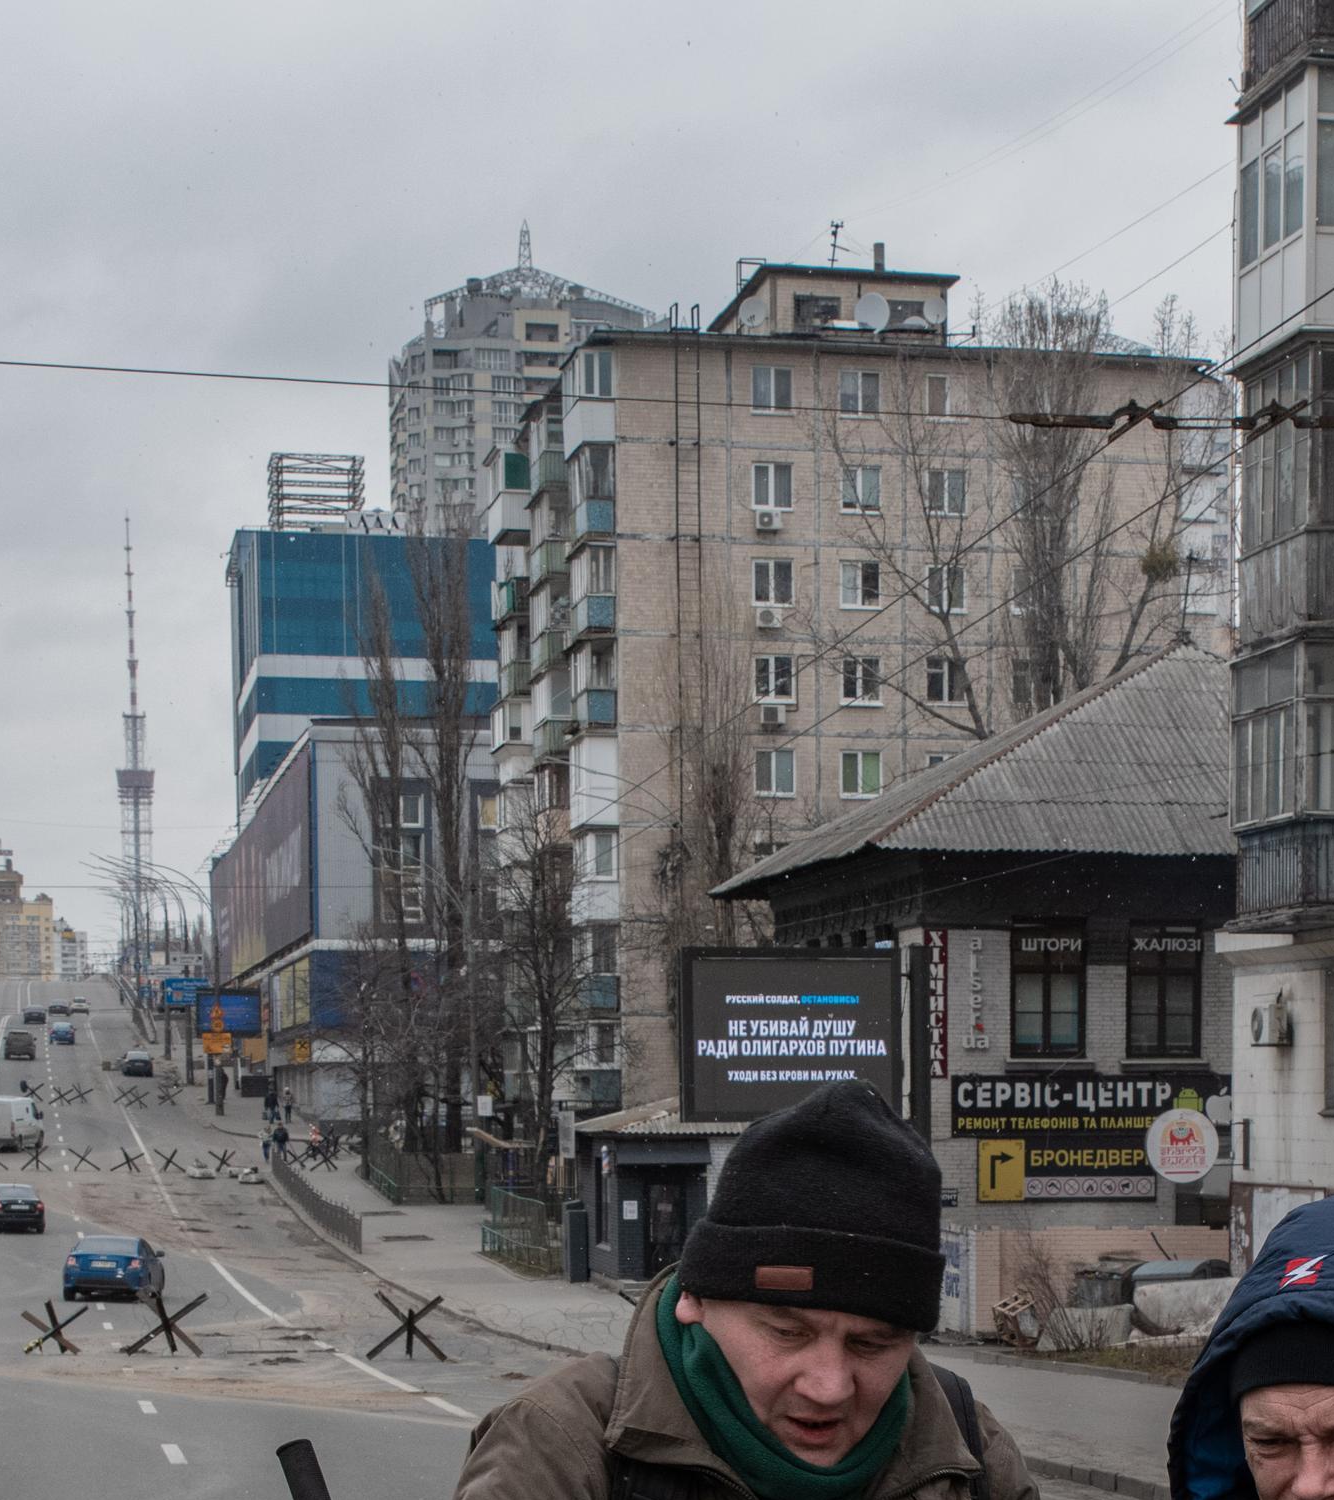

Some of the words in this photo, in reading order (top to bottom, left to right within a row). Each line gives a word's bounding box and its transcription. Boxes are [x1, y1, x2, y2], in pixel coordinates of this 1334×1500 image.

[1021, 937, 1082, 952] ШТОРИ
[1132, 937, 1202, 952] ЖАЛЮЗІ
[725, 993, 764, 1004] РУССКИЙ
[765, 995, 800, 1005] СОЛДАТ,
[929, 930, 946, 1077] ХІМЧИСТКА
[728, 1020, 747, 1036] НЕ
[750, 1016, 809, 1037] УБИВАЙ
[812, 1020, 856, 1038] ДУШУ
[697, 1040, 738, 1059] РАДИ
[741, 1040, 826, 1056] ОЛИГАРХОВ
[829, 1040, 887, 1056] ПУТИНА
[727, 1070, 758, 1082] УХОДИ
[760, 1070, 777, 1081] БЕЗ
[779, 1070, 809, 1081] КРОВИ
[811, 1070, 823, 1081] НА
[957, 1081, 1172, 1112] СЕРВІС-ЦЕНТР
[958, 1117, 1007, 1129] РЕМОНТ
[1011, 1117, 1079, 1129] ТЕЛЕФОНІВ
[1083, 1117, 1097, 1129] ТА
